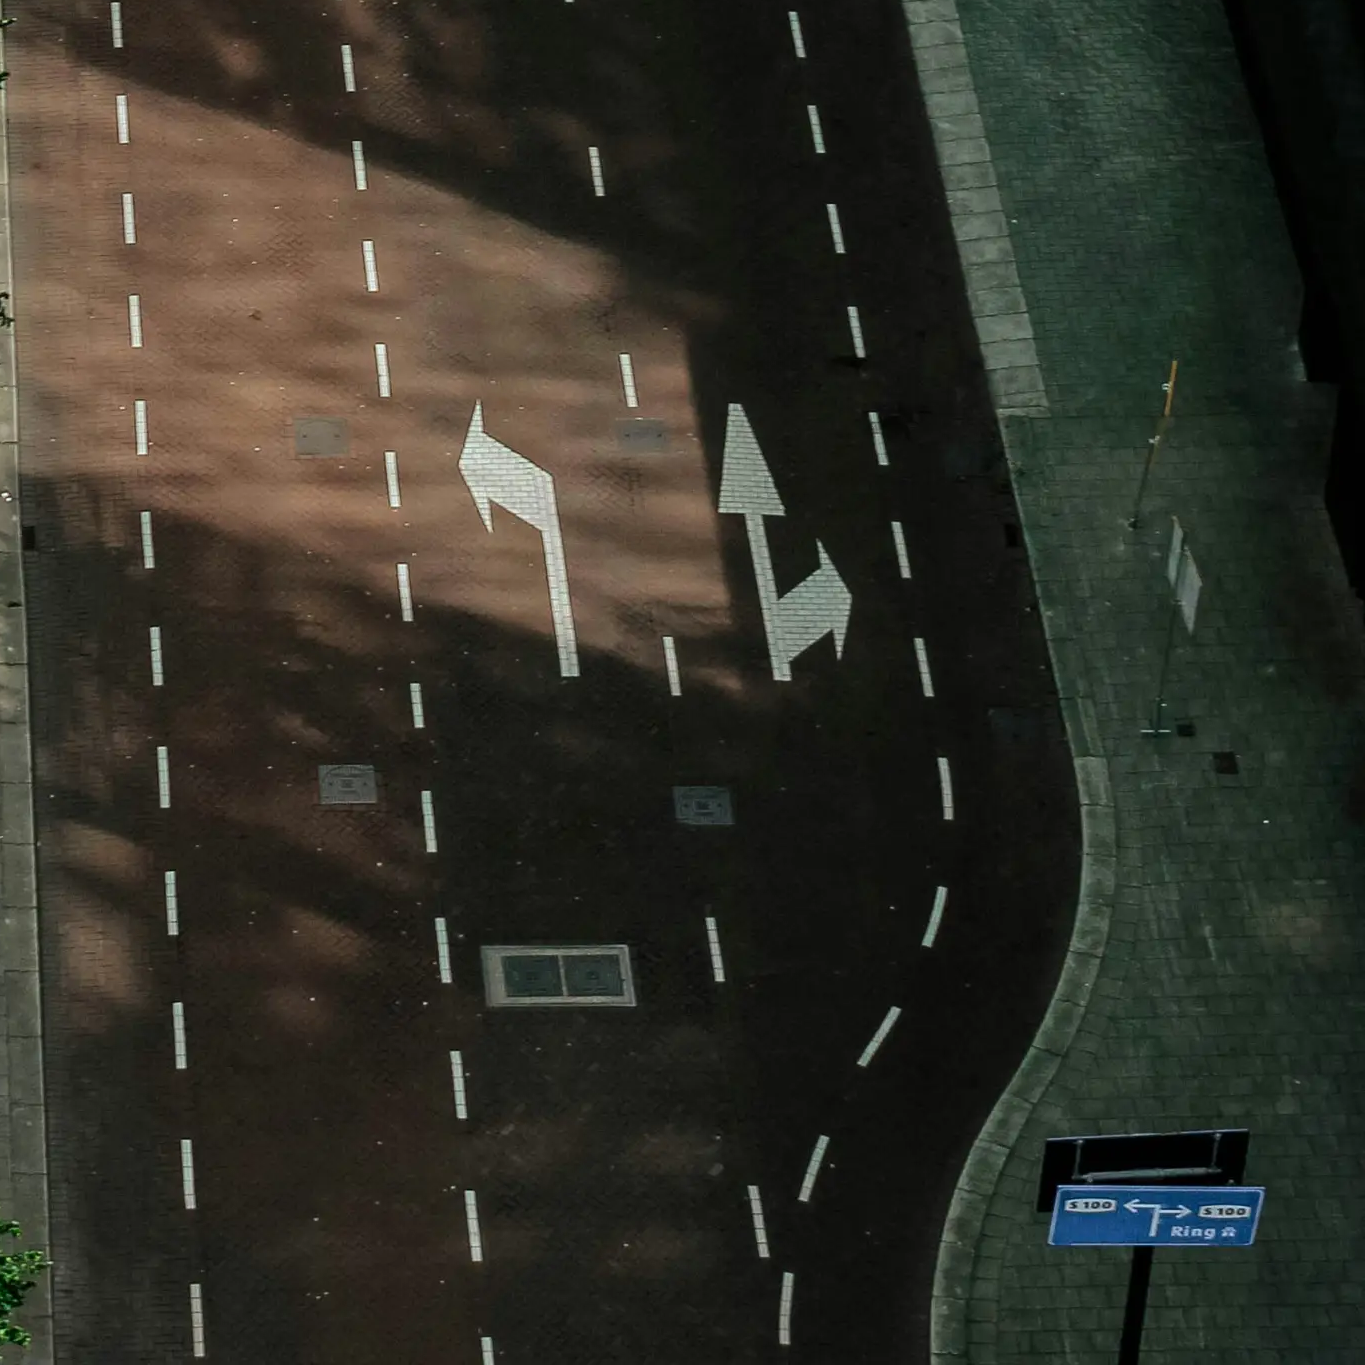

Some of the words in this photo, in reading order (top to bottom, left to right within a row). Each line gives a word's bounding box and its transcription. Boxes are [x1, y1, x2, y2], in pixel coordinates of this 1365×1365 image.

[1069, 1201, 1078, 1209] S
[1082, 1201, 1112, 1209] 100
[1202, 1207, 1212, 1215] S
[1216, 1207, 1246, 1215] 100
[1171, 1225, 1215, 1240] Ring
